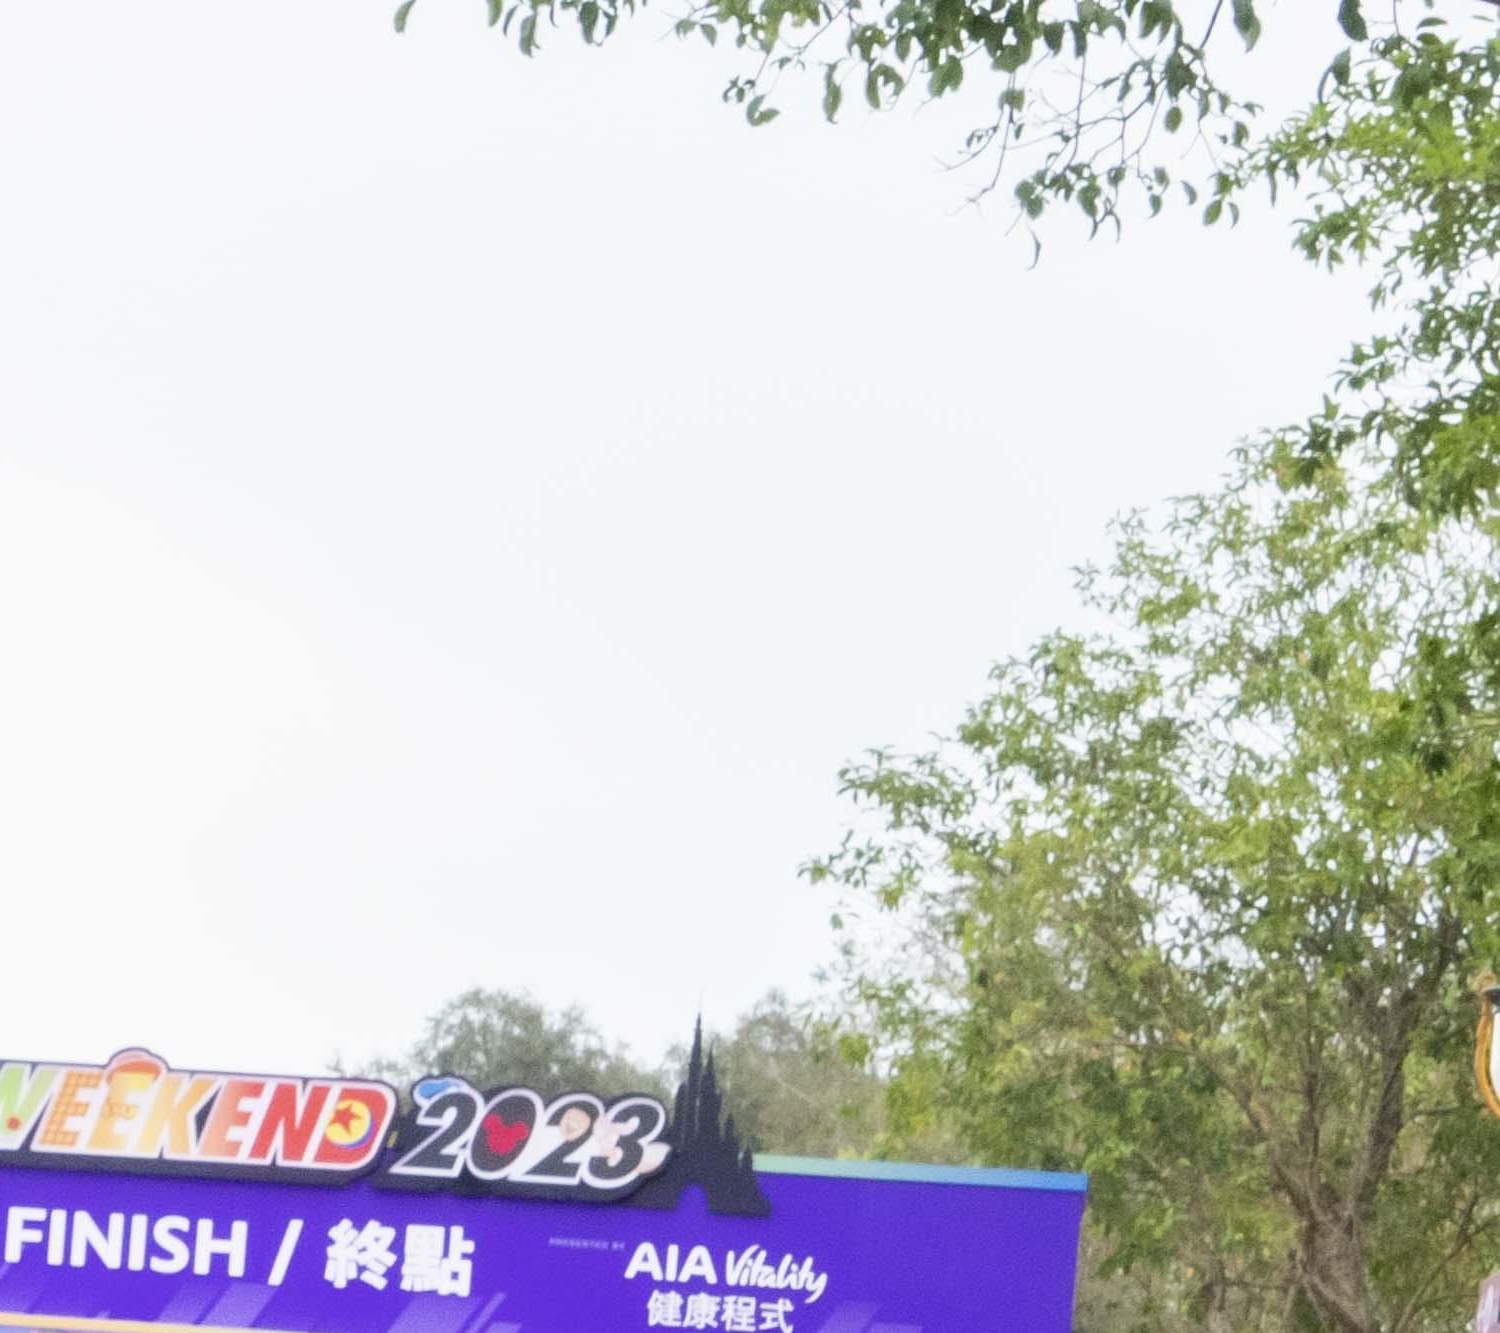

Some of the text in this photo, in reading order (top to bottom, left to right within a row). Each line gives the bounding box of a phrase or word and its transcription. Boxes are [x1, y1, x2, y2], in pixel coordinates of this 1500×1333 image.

[388, 1076, 670, 1192] 2023
[4, 1206, 476, 1297] FINISH / 終點
[624, 1241, 828, 1304] AIA Vitality
